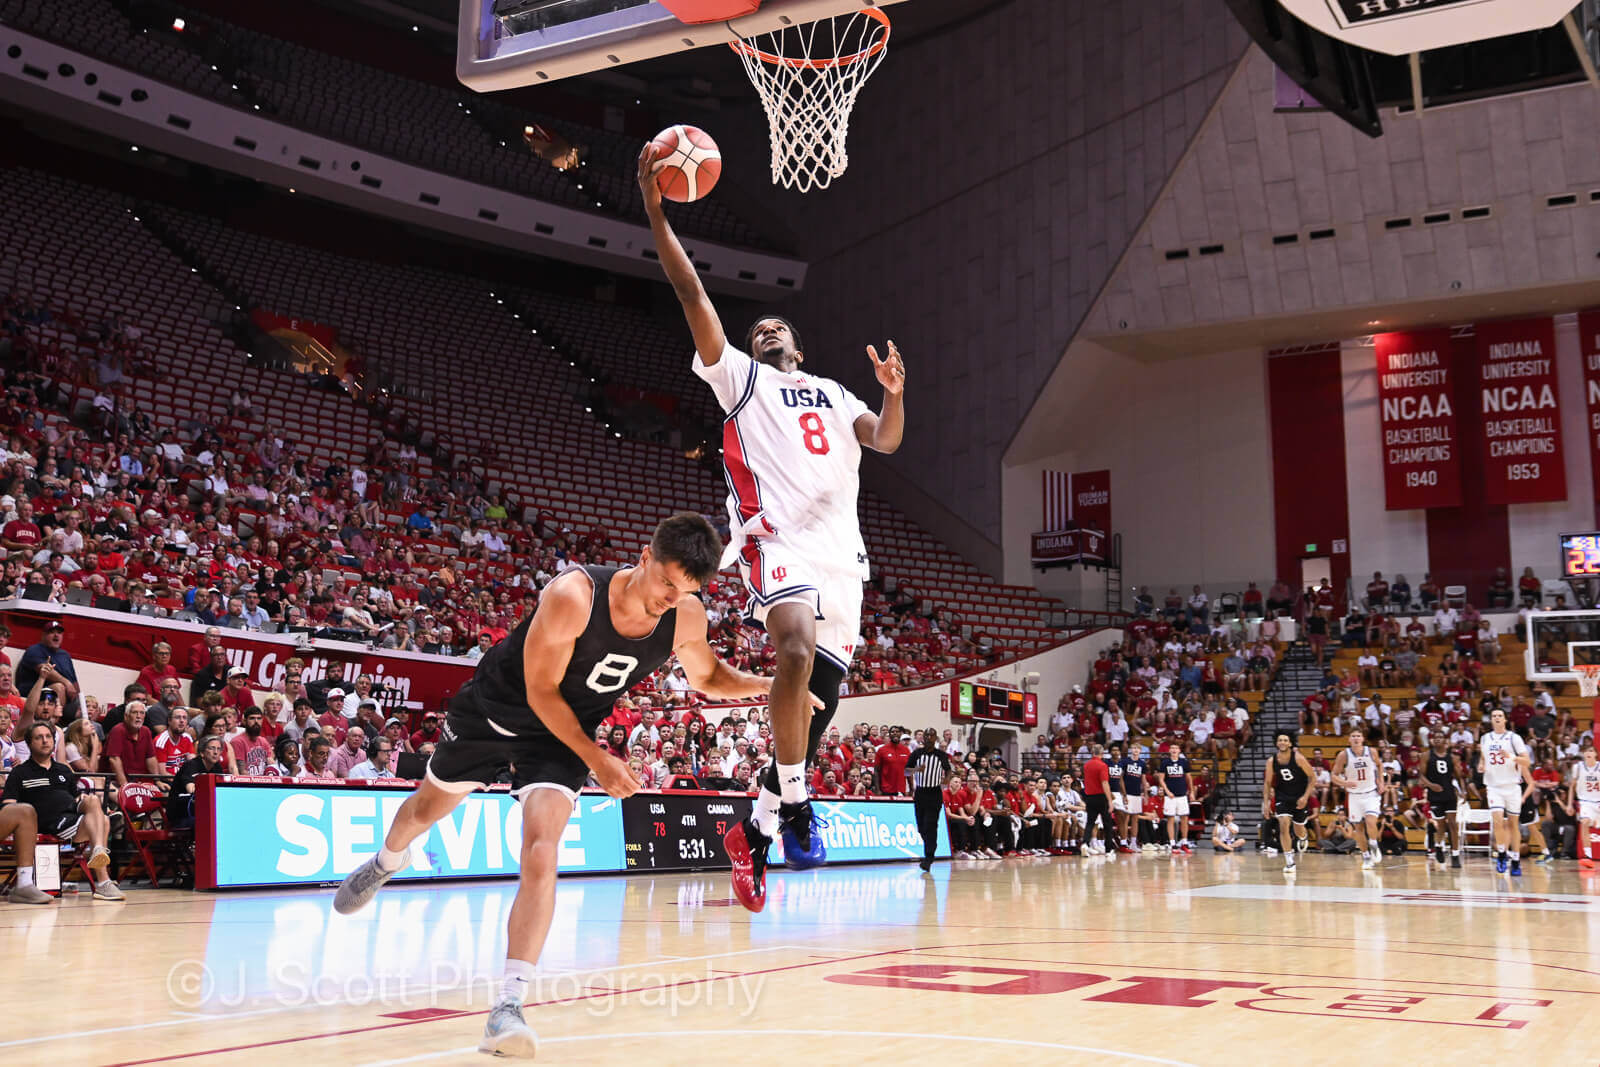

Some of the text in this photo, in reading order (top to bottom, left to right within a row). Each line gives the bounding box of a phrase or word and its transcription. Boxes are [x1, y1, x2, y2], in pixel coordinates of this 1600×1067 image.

[1489, 340, 1543, 360] INDIANA
[1388, 351, 1439, 370] INDIANA
[1482, 359, 1550, 380] UNIVERSITY
[1382, 368, 1448, 389] UNIVERSITY
[780, 387, 833, 409] USA
[1482, 384, 1557, 413] NCAA
[1383, 393, 1452, 422] NCAA
[798, 411, 831, 456] 8
[1386, 426, 1452, 446] BASKETBALL
[1486, 417, 1556, 437] BASKETBALL
[1389, 445, 1450, 464] CHAMPIONS
[1490, 437, 1555, 457] CHAMPIONS
[1406, 470, 1438, 487] 1940
[1507, 463, 1541, 481] 1953
[1489, 752, 1505, 765] 33
[1126, 763, 1142, 775] USA
[1166, 765, 1184, 775] USA
[1357, 769, 1366, 781] 11
[650, 803, 666, 815] USA
[707, 804, 734, 815] CANADA
[653, 822, 666, 837] 78
[681, 815, 697, 827] 4TH
[716, 821, 728, 836] 57
[625, 842, 654, 853] FOULS 3
[678, 838, 706, 859] 5:31
[650, 856, 655, 867] 1
